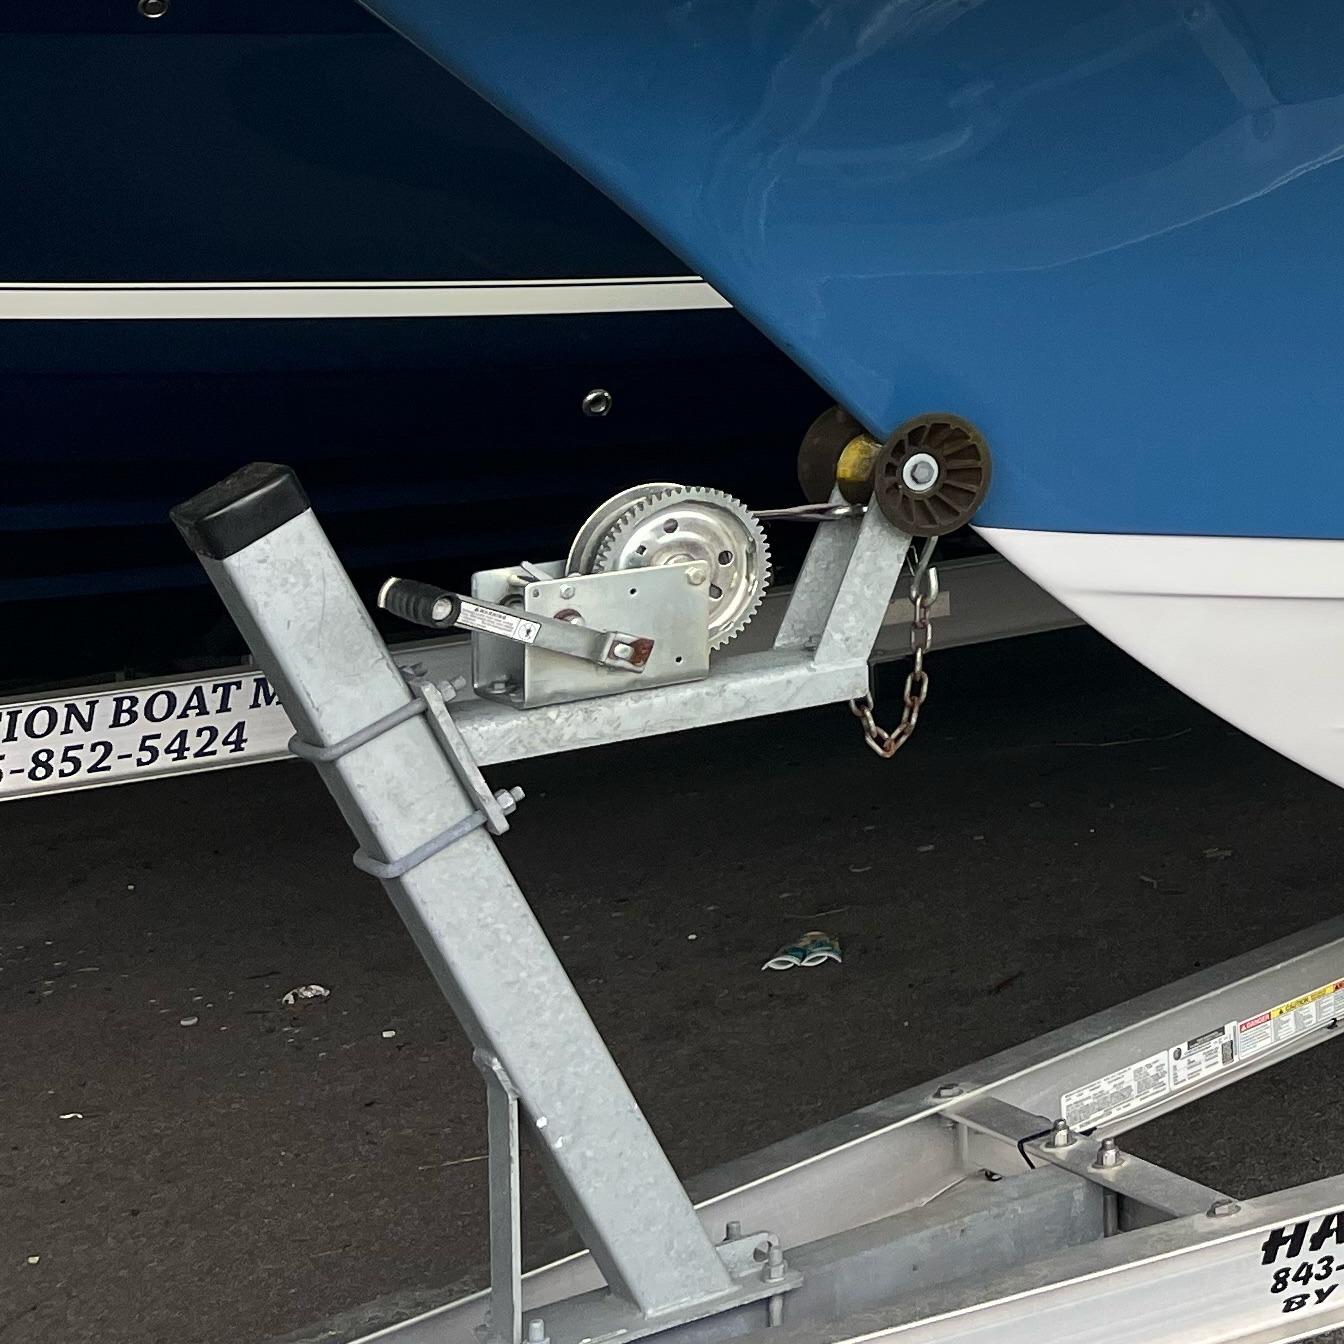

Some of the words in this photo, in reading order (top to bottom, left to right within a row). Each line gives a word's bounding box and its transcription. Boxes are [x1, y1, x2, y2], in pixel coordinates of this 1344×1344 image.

[0, 699, 99, 744] ION
[109, 680, 242, 729] BOAT
[0, 721, 248, 783] -852-5424
[1282, 1283, 1339, 1313] BY
